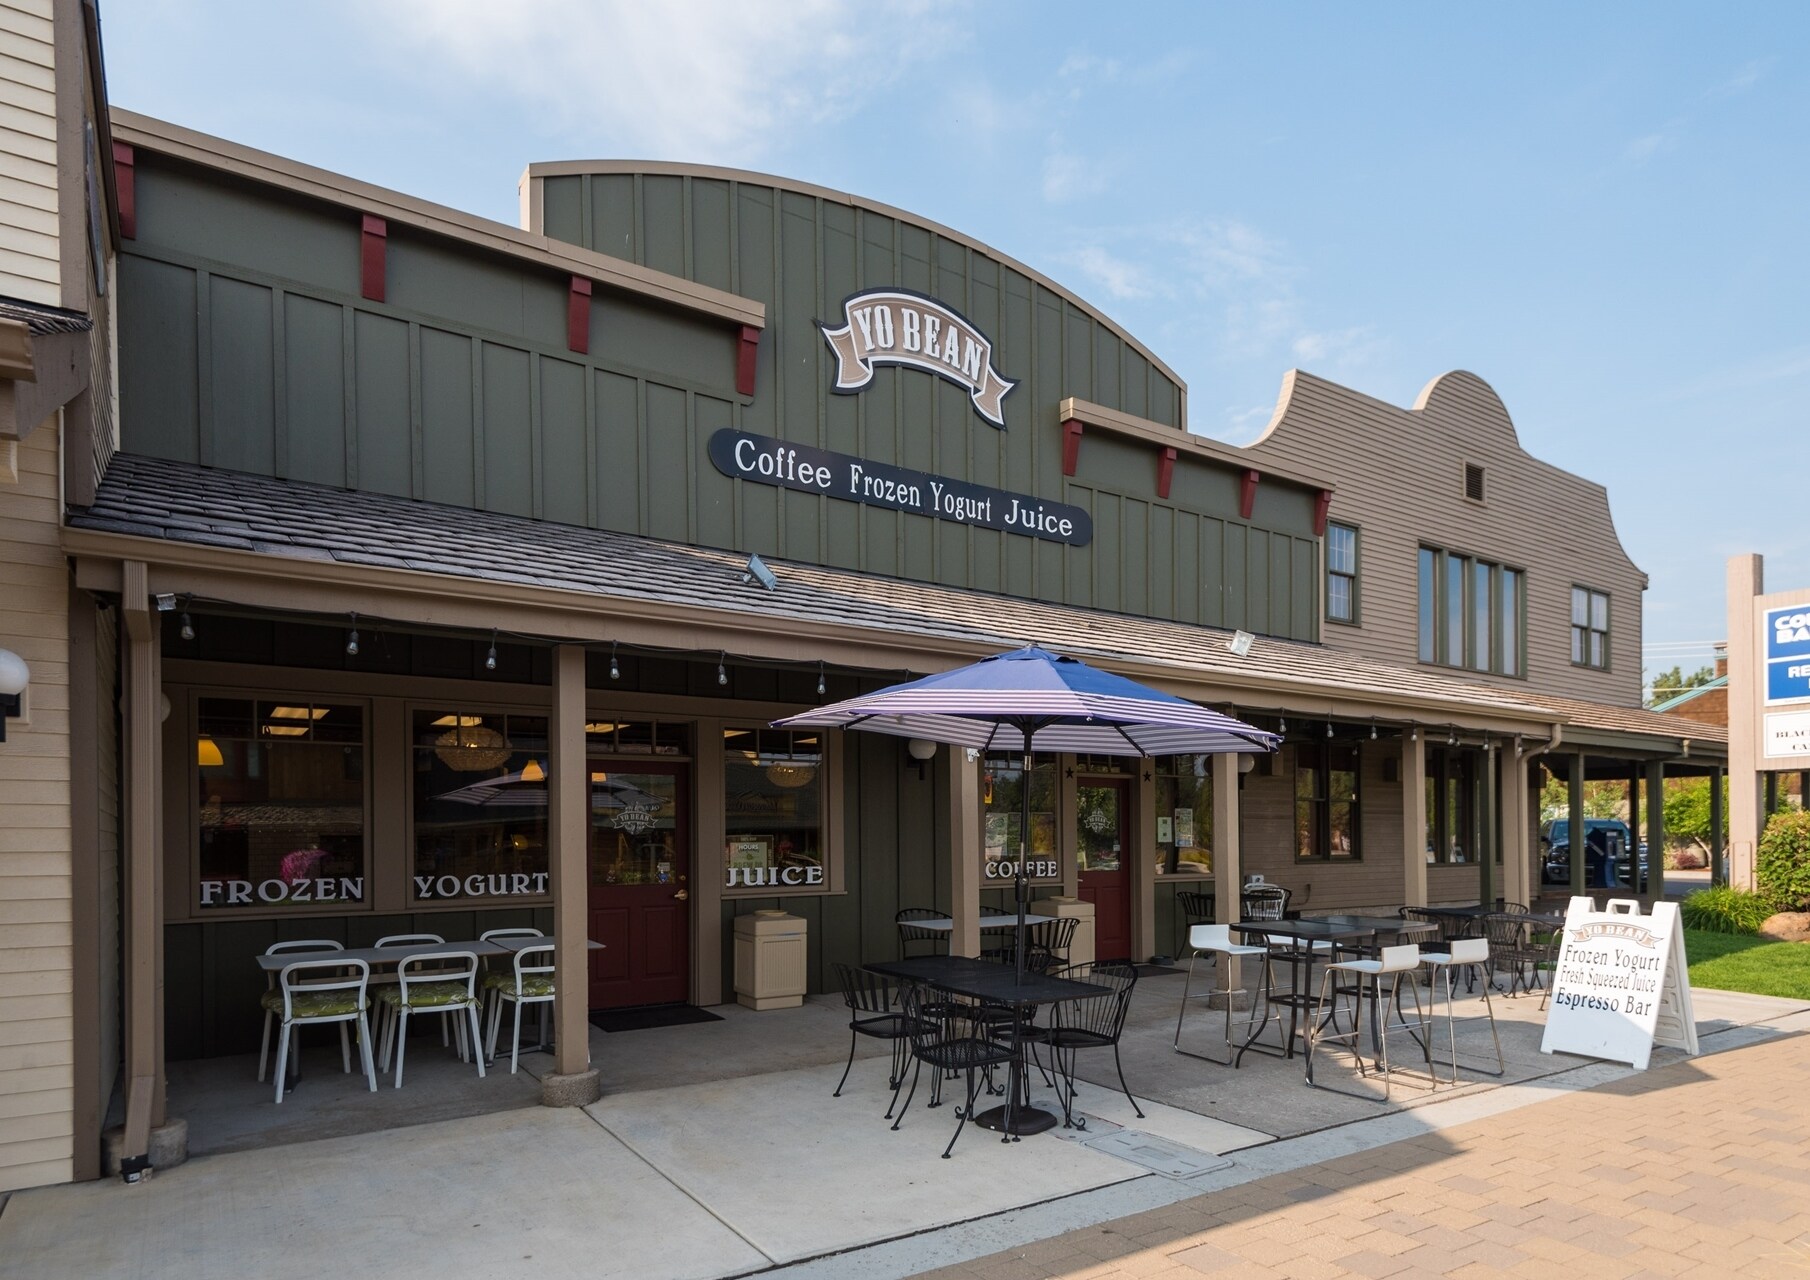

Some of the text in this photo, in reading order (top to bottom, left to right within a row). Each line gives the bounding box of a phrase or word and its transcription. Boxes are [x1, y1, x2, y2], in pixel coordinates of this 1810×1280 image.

[852, 305, 984, 381] YO BEAN
[734, 439, 1073, 537] Coffee Frozen Yogurt Juice
[1774, 612, 1810, 630] CO
[1776, 729, 1810, 738] BLAC
[200, 876, 364, 904] FROZEN
[413, 872, 549, 898] YOGURT
[726, 866, 823, 887] JUICE
[1585, 924, 1645, 941] YO BEAN
[1564, 944, 1660, 974] Frozen Yogurt
[1560, 964, 1656, 993] Fresh Squeezed Juice
[1555, 987, 1652, 1016] Espresso Bar
